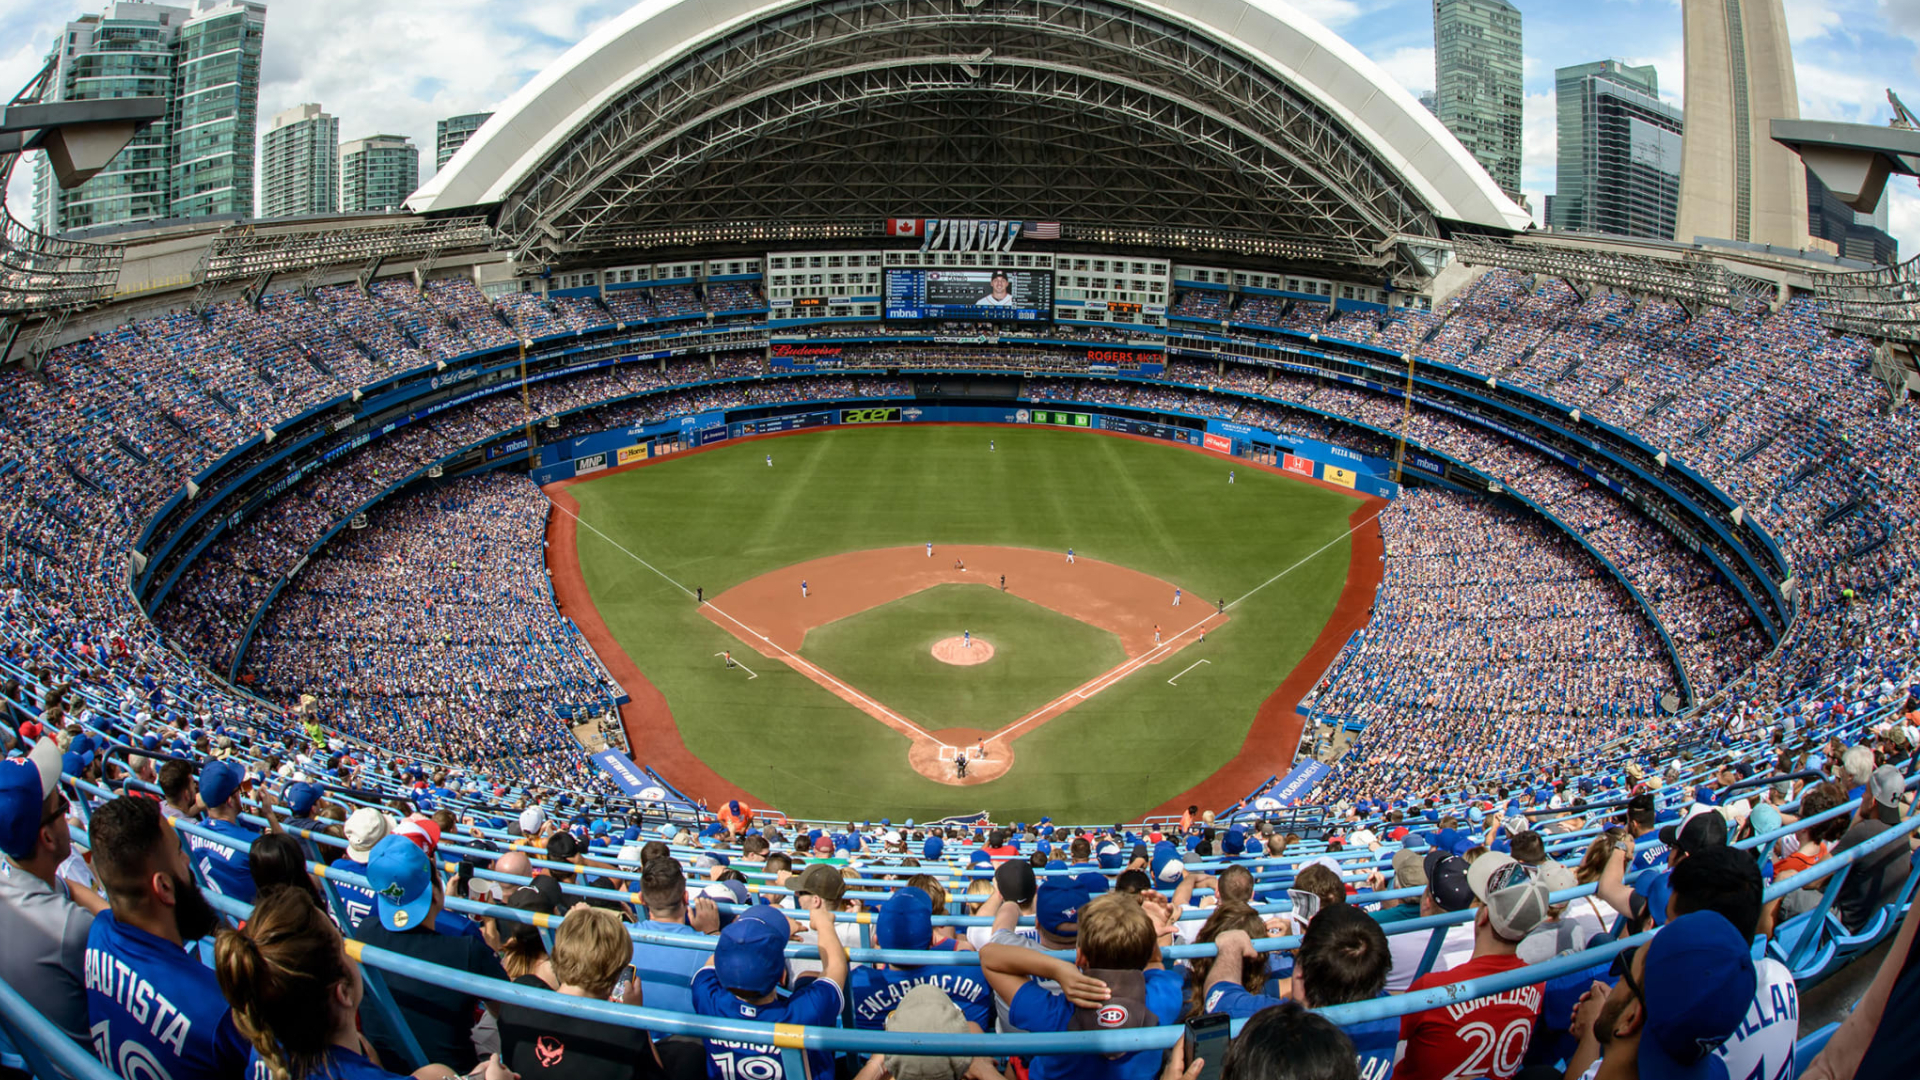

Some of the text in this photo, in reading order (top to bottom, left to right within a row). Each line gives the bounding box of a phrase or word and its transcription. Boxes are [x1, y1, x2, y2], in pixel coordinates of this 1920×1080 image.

[890, 309, 918, 318] mbna
[772, 344, 842, 356] Budweiser
[1087, 350, 1133, 362] ROGERS
[845, 408, 896, 423] acer
[1078, 416, 1086, 424] TD
[506, 440, 528, 452] mbna
[628, 447, 646, 456] Home
[1331, 446, 1348, 457] PIZZA
[580, 455, 603, 470] MNP
[1416, 458, 1438, 472] mbna
[84, 948, 192, 1057] BAUTISTA
[1442, 1018, 1531, 1080] 20
